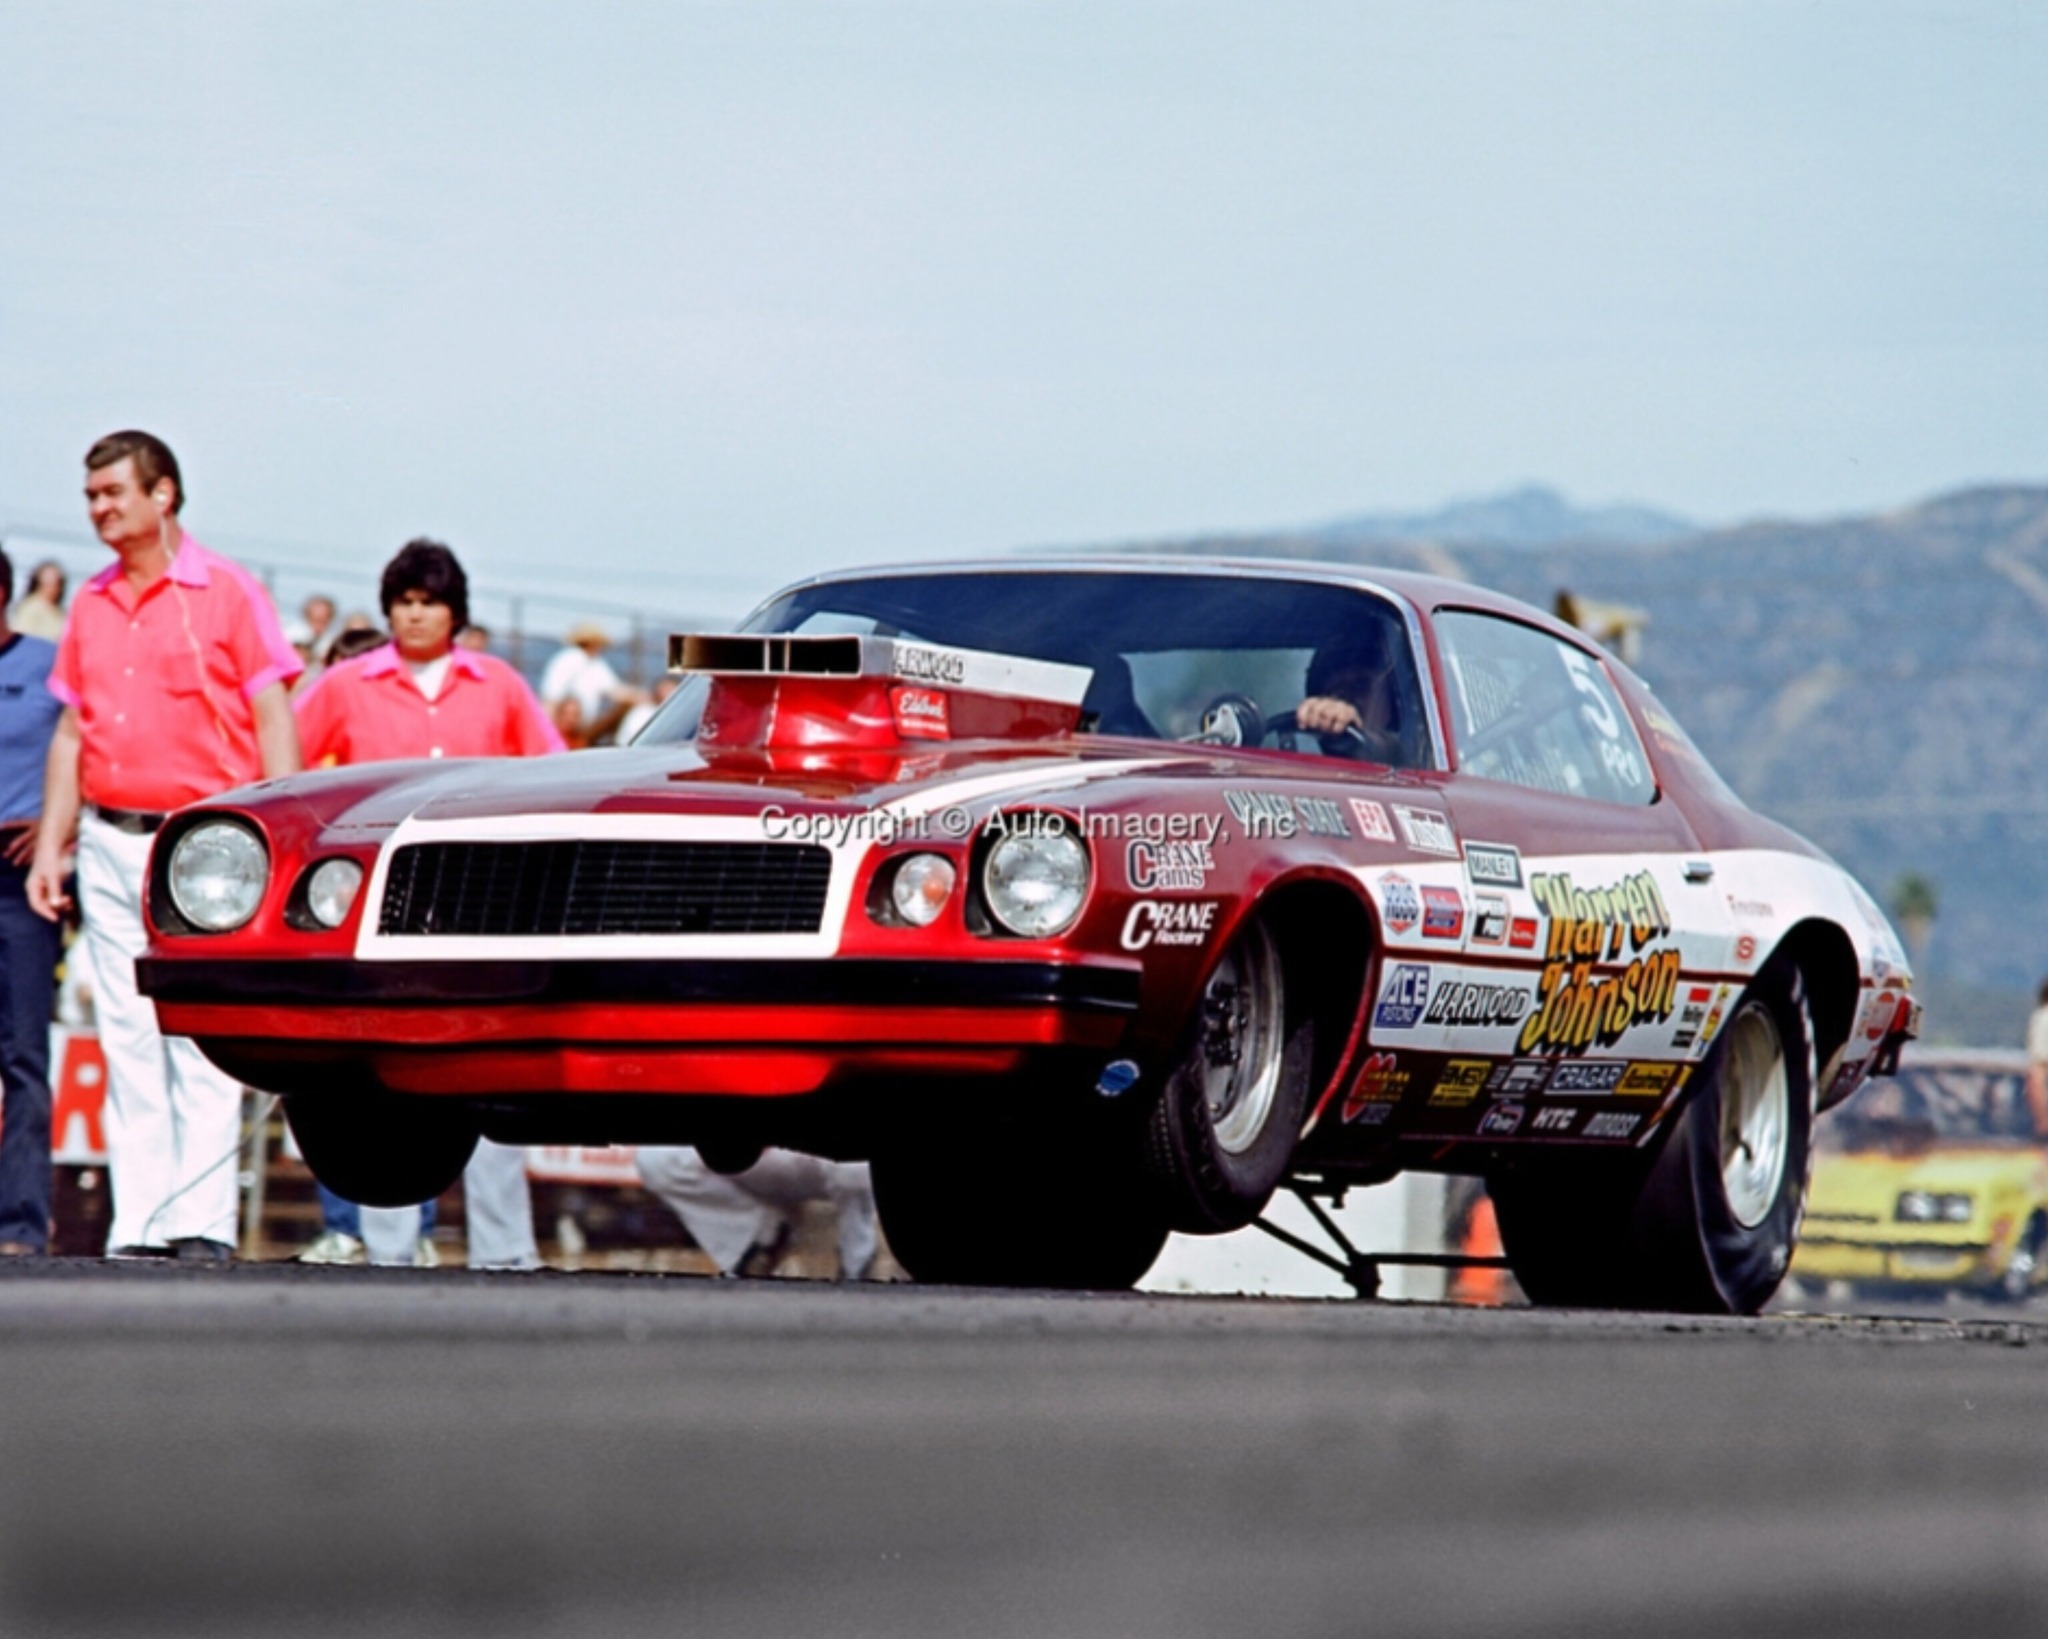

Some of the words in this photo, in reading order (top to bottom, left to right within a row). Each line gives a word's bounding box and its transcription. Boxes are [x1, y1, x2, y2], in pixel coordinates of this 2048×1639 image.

[1120, 899, 1219, 951] CRANE
[1530, 870, 1671, 963] Warren
[1380, 967, 1429, 1006] ACE
[1422, 980, 1533, 1027] HARWOOD
[1513, 946, 1681, 1059] Johnson
